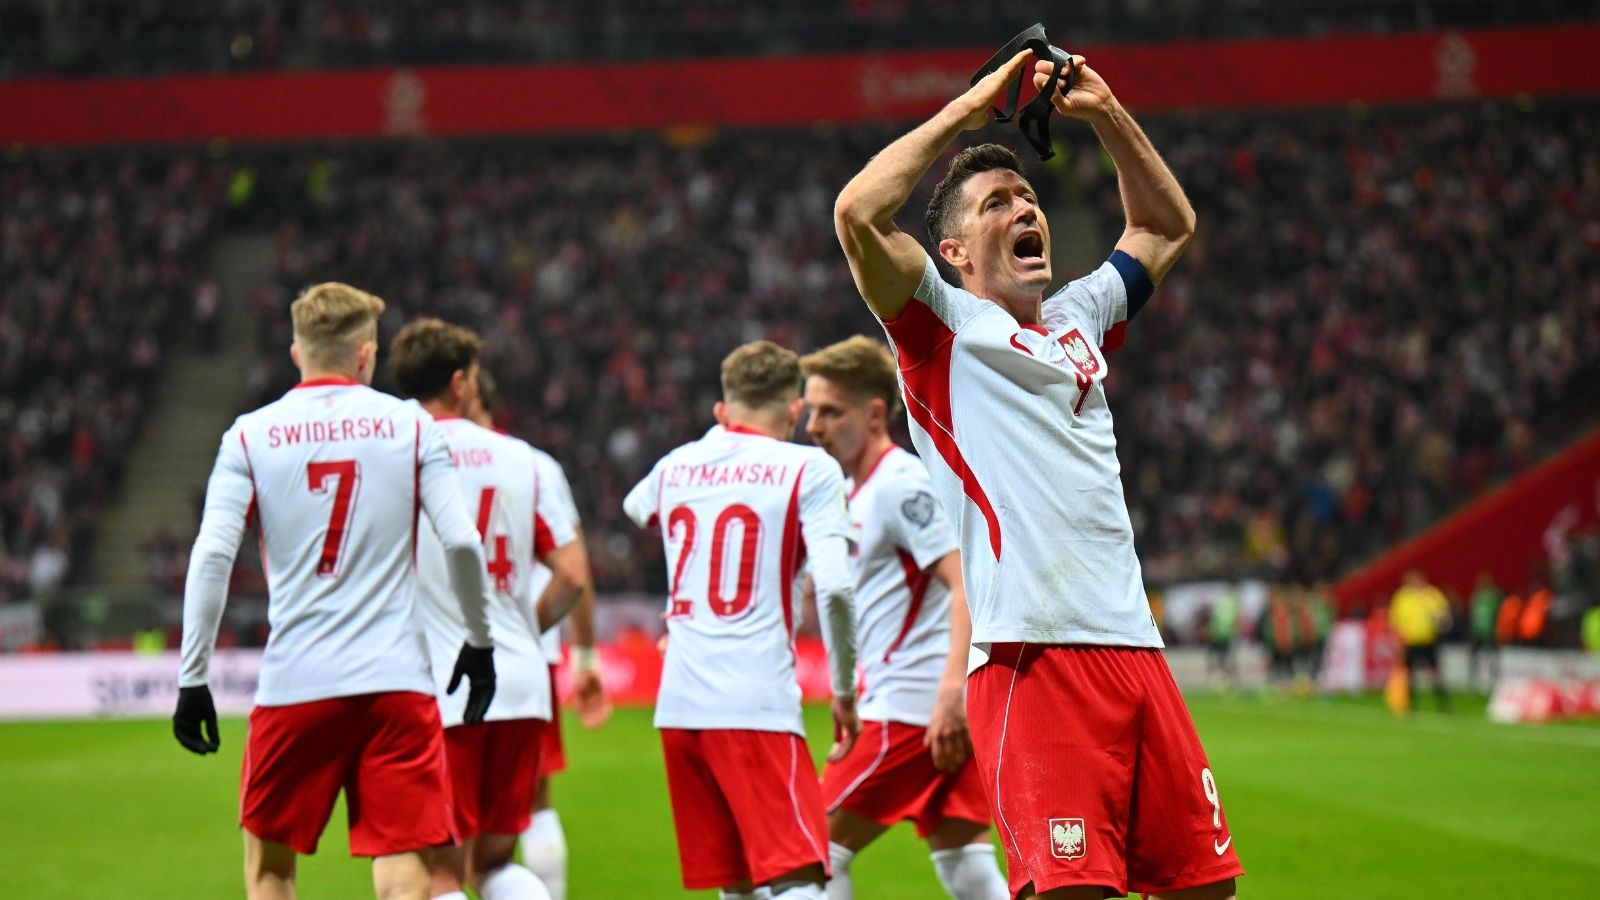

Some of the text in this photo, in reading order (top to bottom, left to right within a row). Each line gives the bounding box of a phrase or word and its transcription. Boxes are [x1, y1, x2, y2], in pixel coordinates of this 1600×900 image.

[307, 459, 361, 578] 7
[476, 486, 517, 594] 4
[668, 503, 763, 619] 20
[1201, 767, 1221, 829] 9
